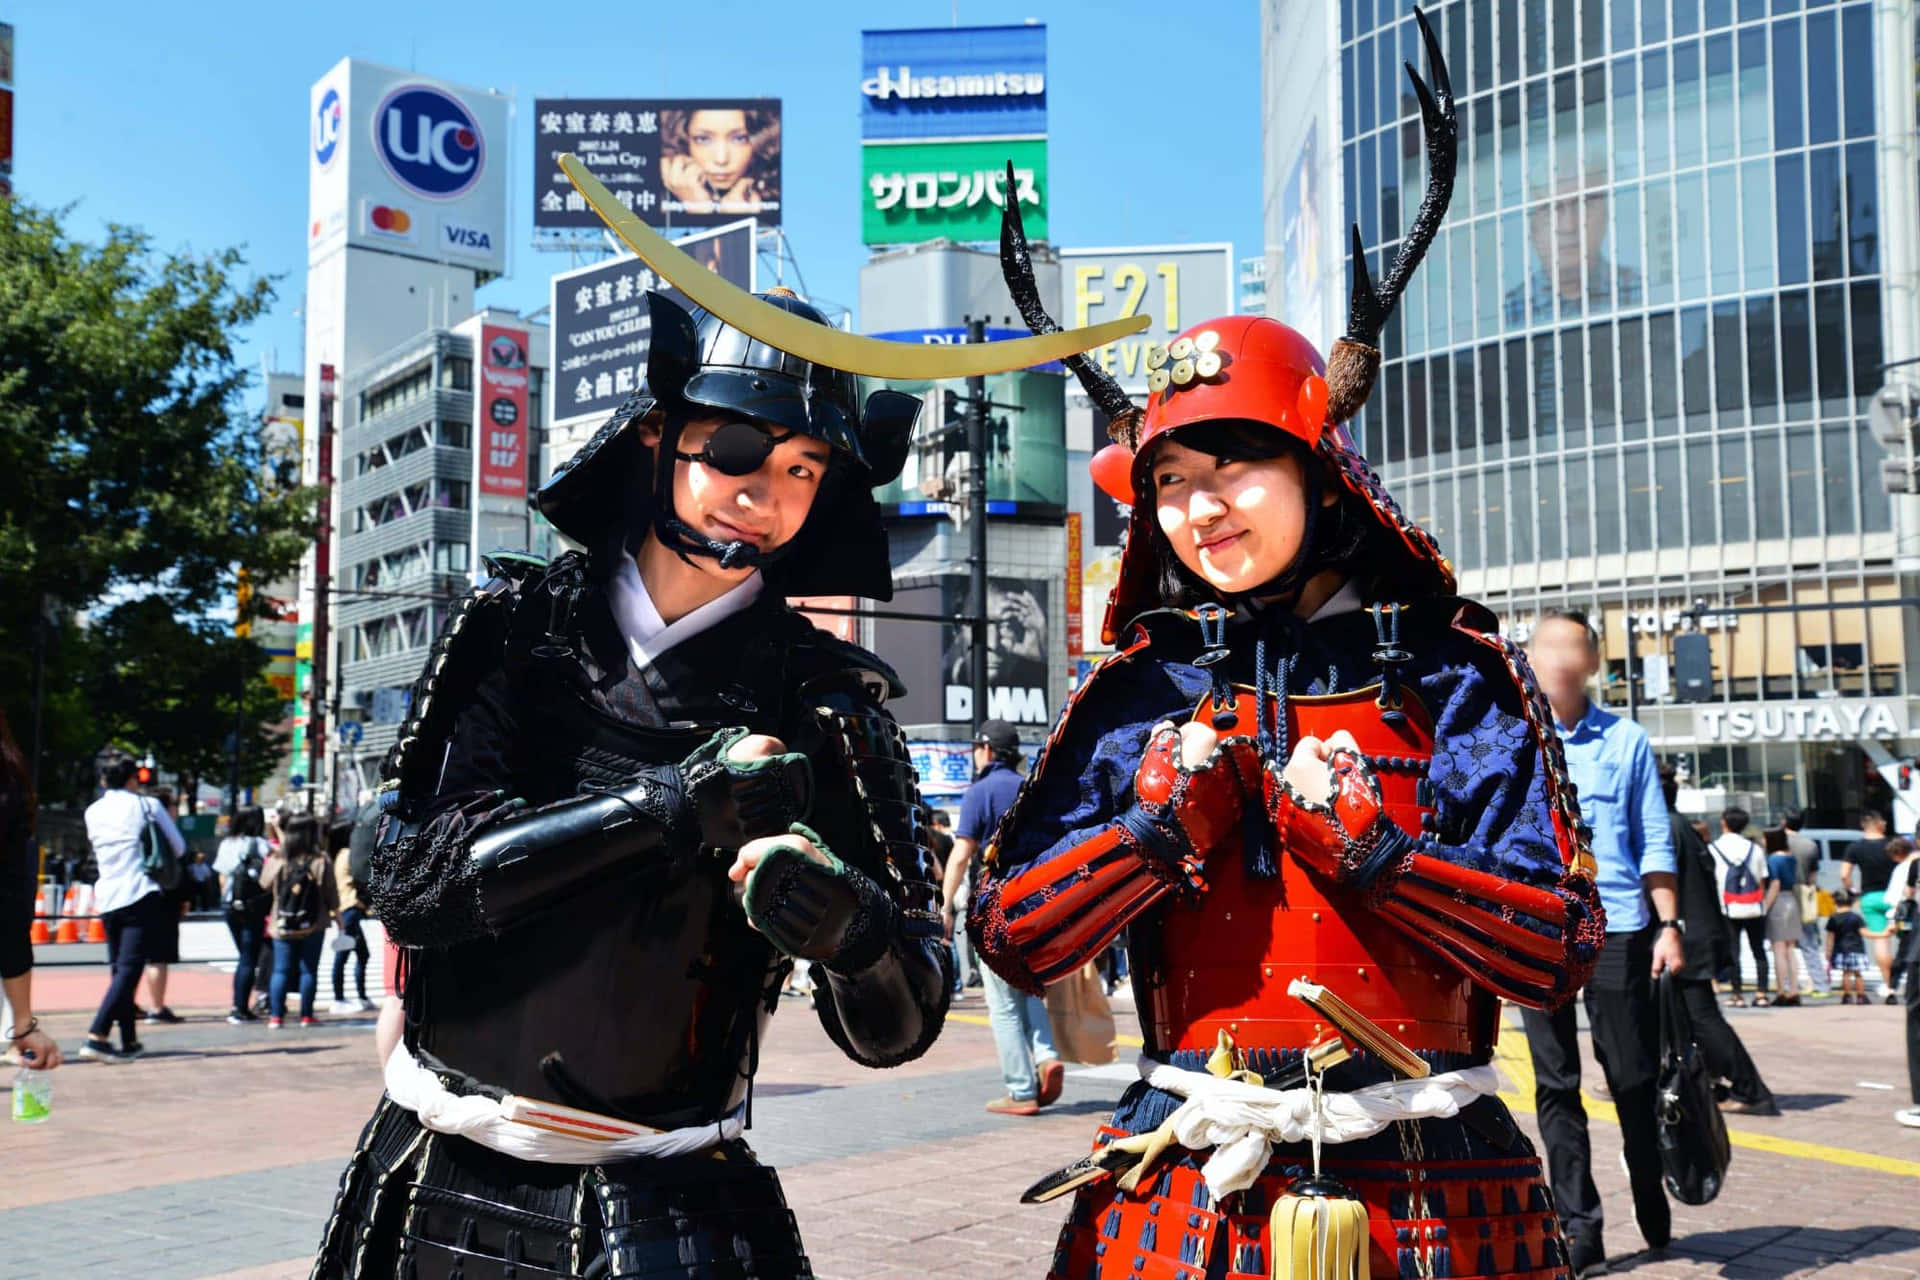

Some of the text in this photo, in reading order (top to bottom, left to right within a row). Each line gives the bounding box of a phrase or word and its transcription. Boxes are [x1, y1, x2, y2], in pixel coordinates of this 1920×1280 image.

[861, 66, 1044, 99] Hisamitsu
[540, 111, 658, 134] 安室奈美恵
[541, 189, 656, 213] 全曲信中
[869, 168, 1040, 211] サロンパス
[446, 225, 491, 250] VISA
[1074, 262, 1179, 334] F21
[1701, 704, 1898, 739] TSUTAYA
